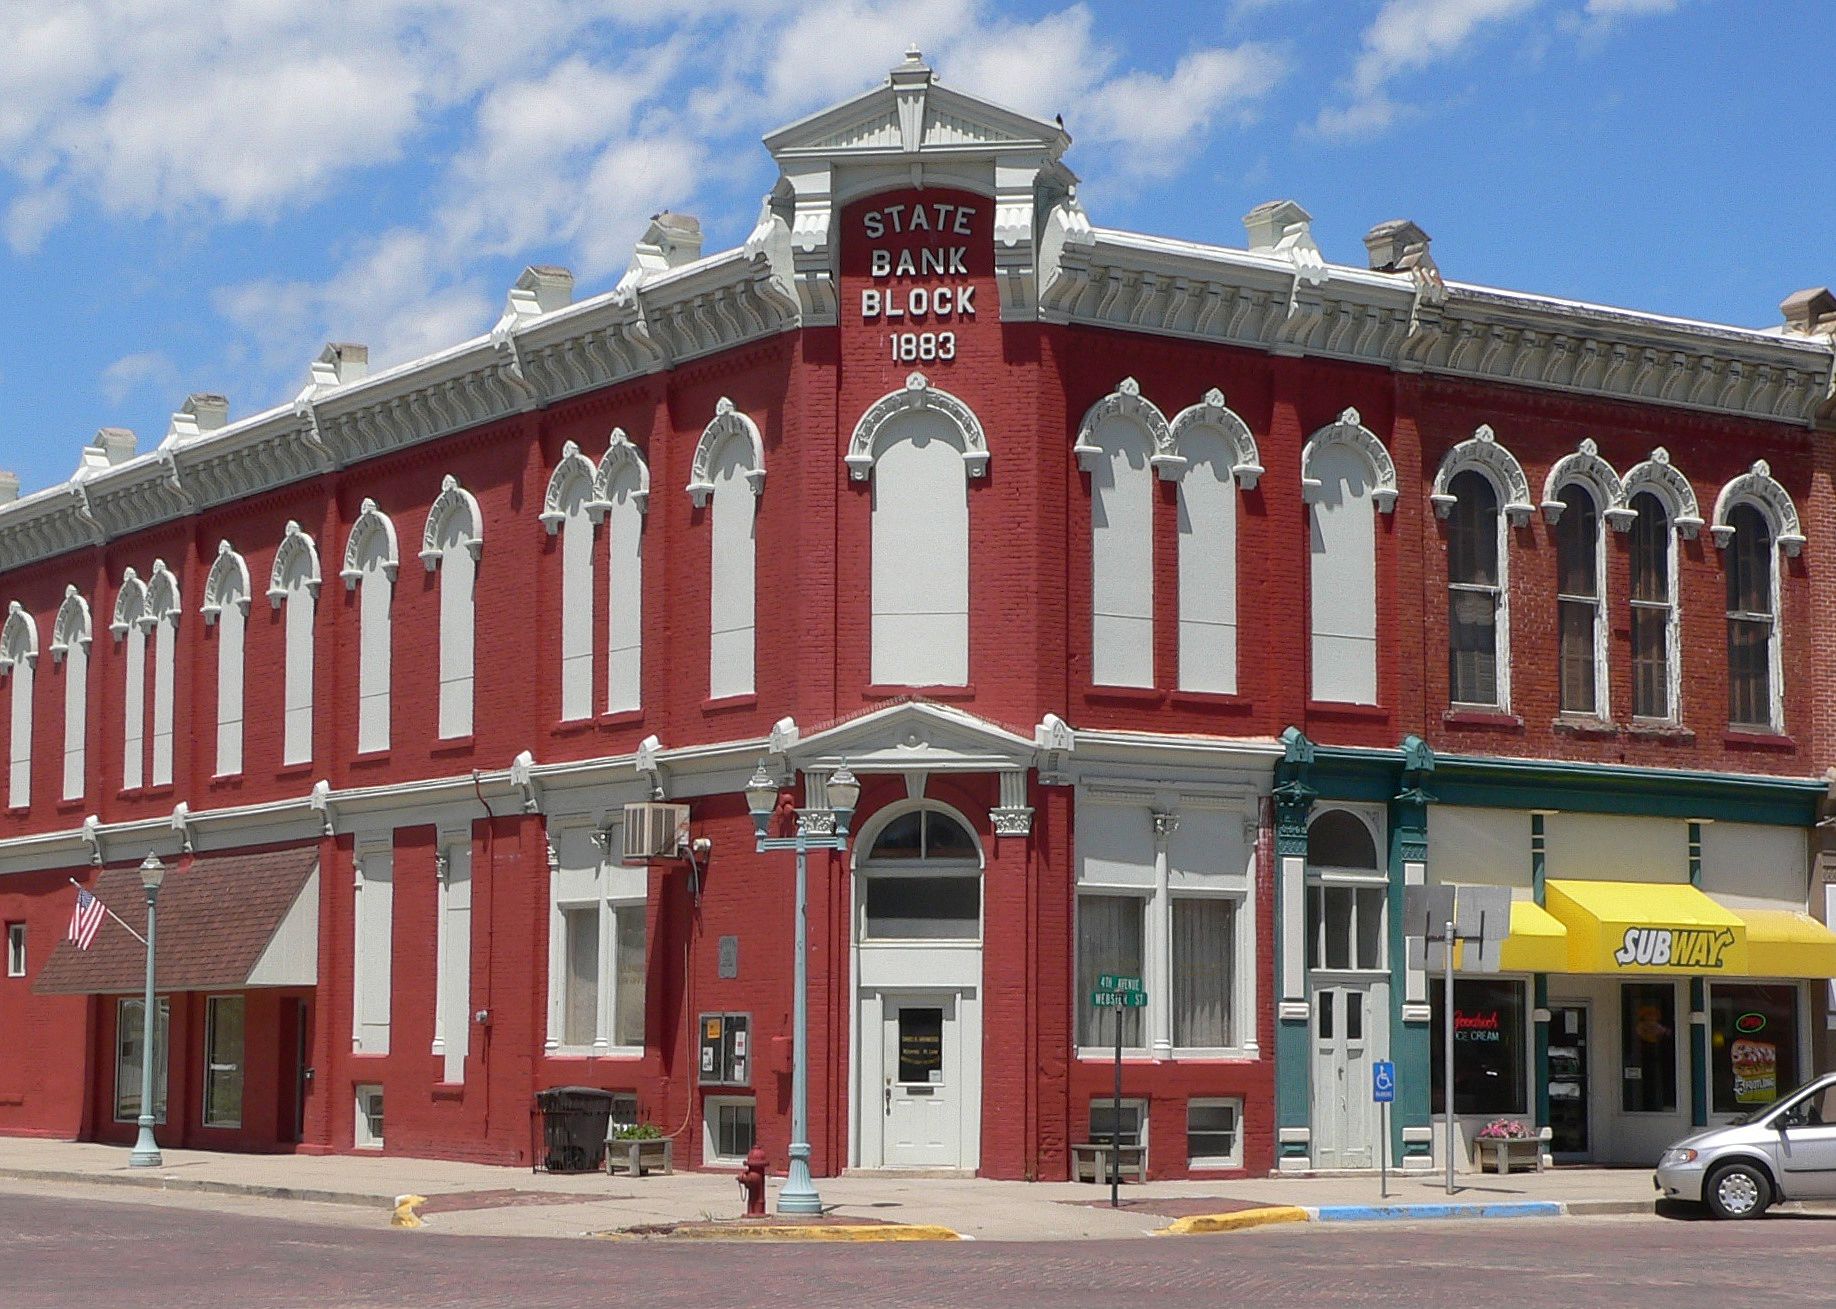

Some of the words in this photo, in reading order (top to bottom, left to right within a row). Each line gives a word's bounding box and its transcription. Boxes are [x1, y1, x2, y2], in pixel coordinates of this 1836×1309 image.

[863, 203, 976, 238] STATE
[872, 247, 967, 276] BANK
[862, 286, 975, 316] BLOCK
[890, 332, 955, 360] 1883
[1614, 926, 1735, 967] SUBWAY
[1101, 976, 1112, 988] 4TH
[1118, 978, 1140, 991] AVENUE
[1135, 993, 1143, 1006] ST
[1470, 1030, 1499, 1041] CREAM
